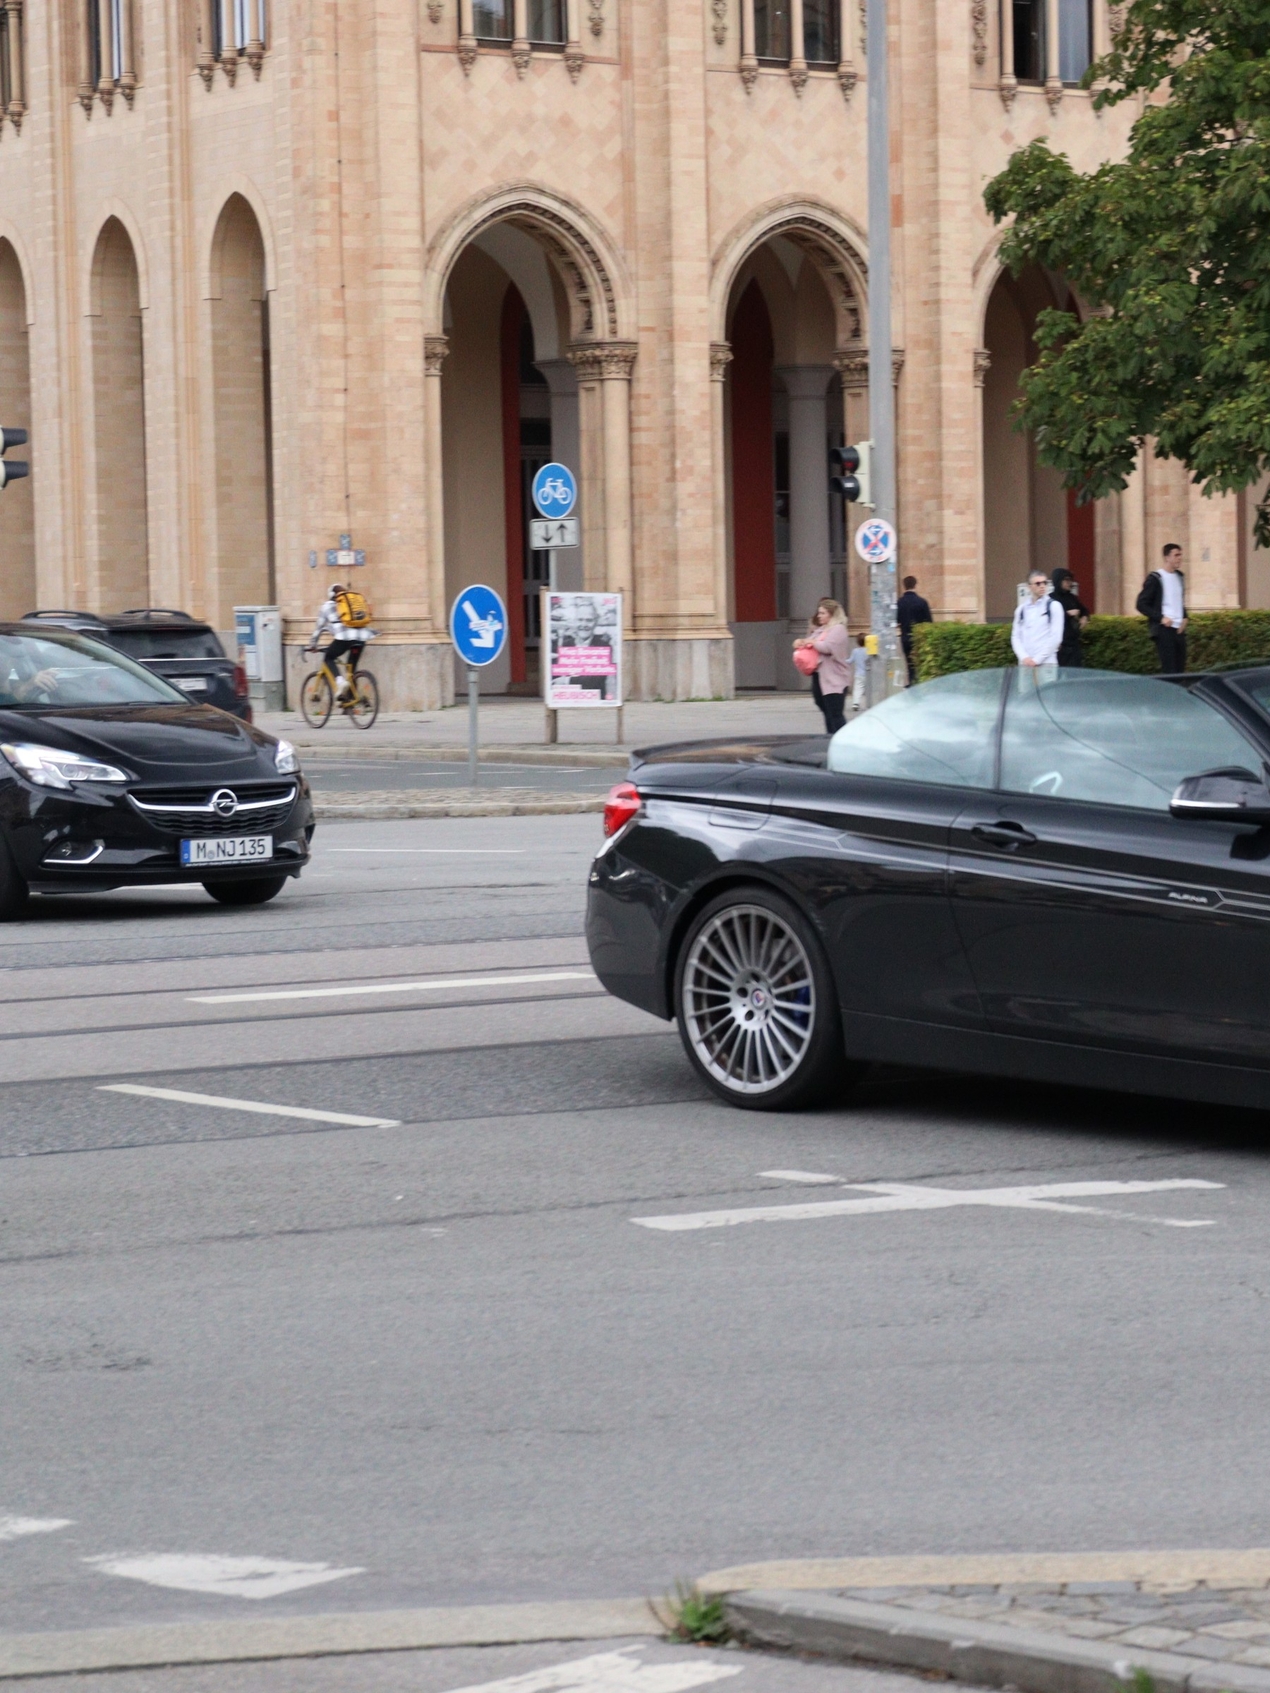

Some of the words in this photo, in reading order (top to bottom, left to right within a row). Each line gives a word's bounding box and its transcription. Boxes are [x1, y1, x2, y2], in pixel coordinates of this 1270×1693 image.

[196, 842, 206, 859] M
[216, 840, 236, 858] NJ
[239, 839, 266, 856] 135
[1168, 891, 1208, 904] ALPINA
